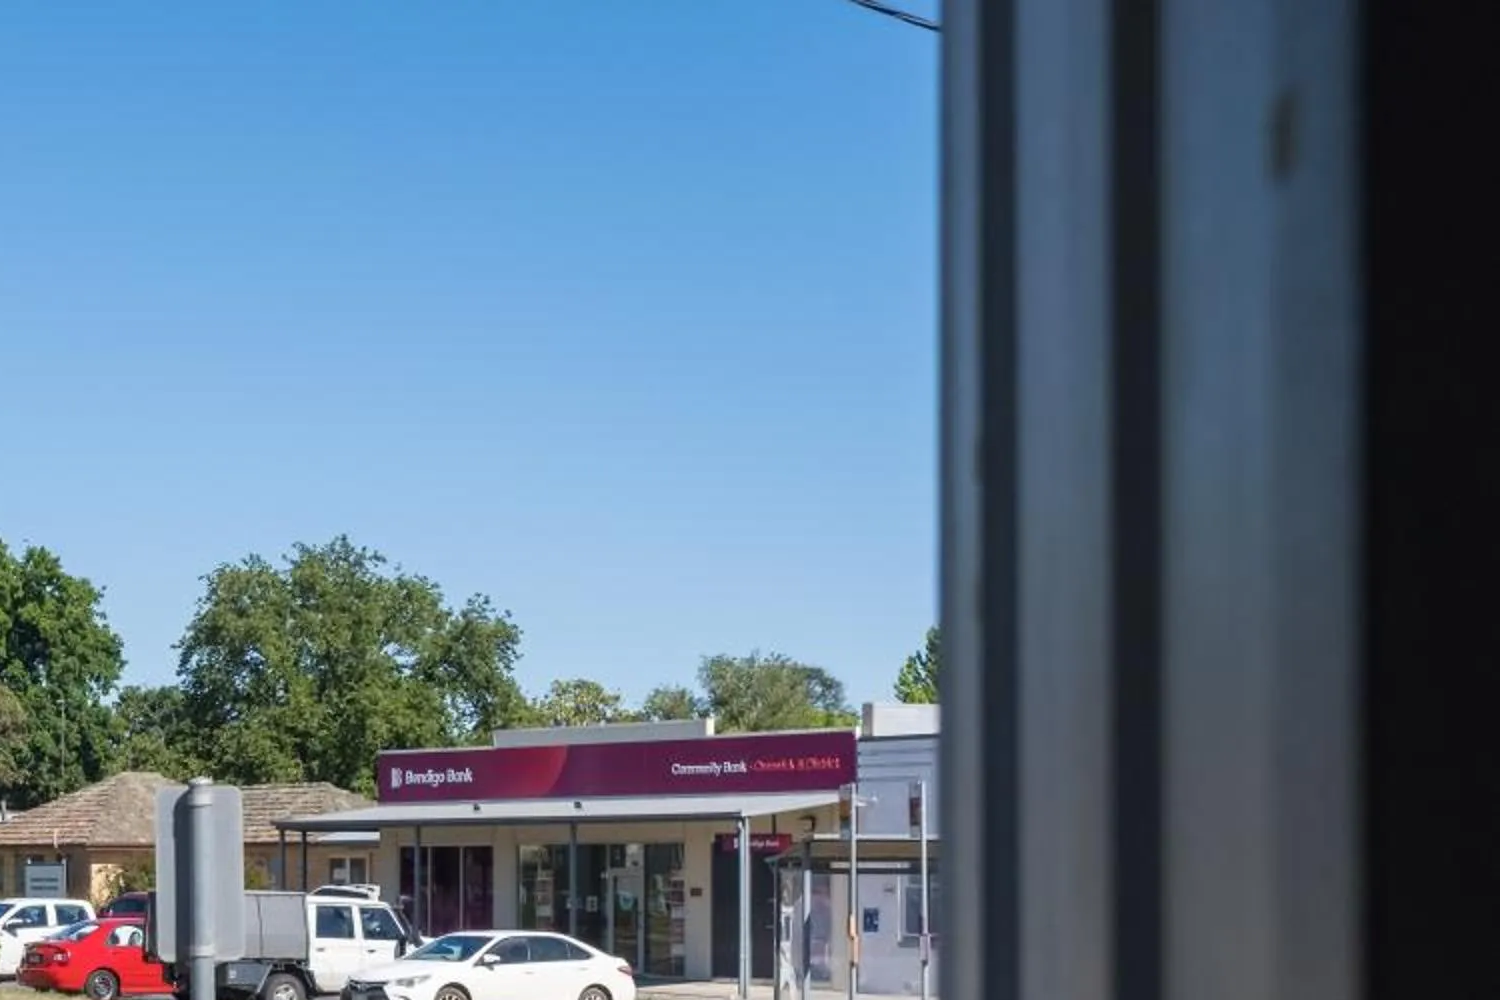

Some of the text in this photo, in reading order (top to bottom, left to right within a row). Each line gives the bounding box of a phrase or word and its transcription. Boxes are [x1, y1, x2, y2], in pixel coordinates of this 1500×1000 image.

[405, 769, 445, 787] Bendigo
[447, 767, 473, 783] Bank
[671, 761, 721, 776] Community
[723, 760, 747, 773] Bank
